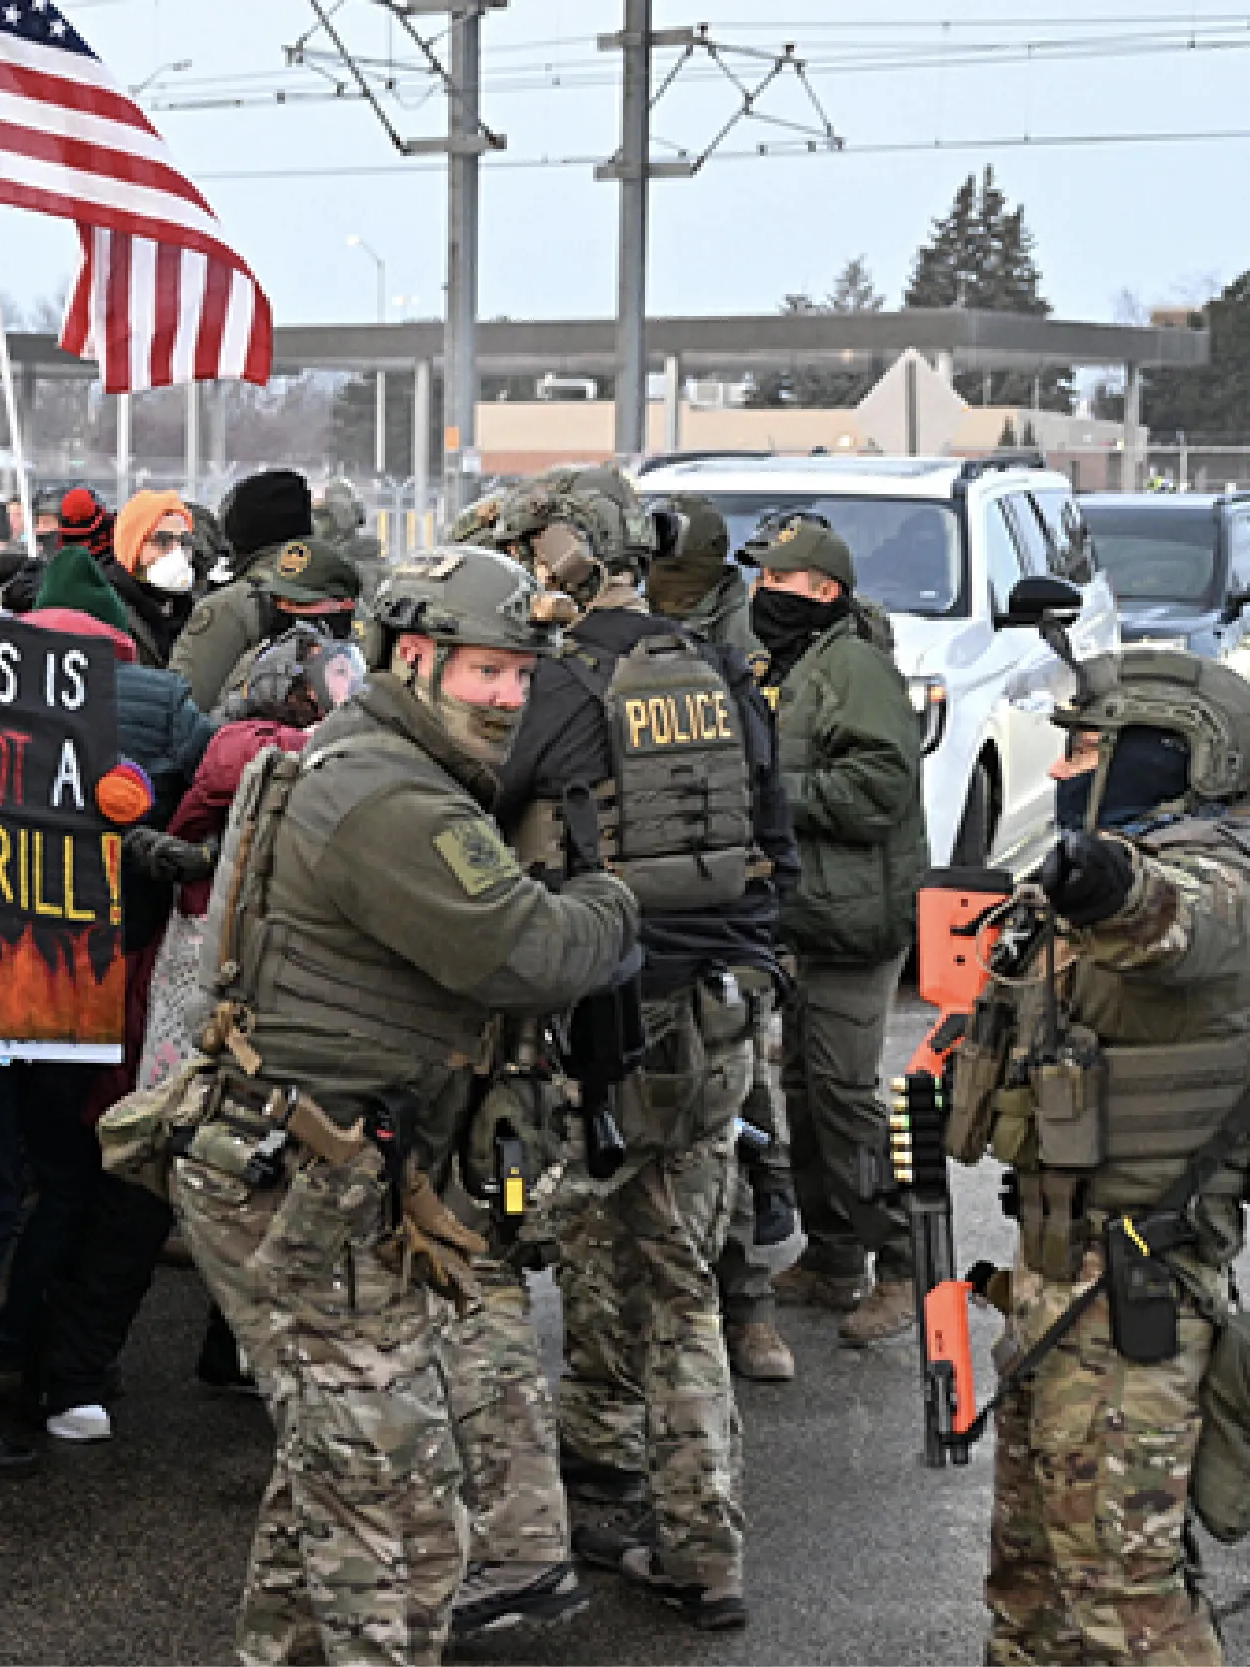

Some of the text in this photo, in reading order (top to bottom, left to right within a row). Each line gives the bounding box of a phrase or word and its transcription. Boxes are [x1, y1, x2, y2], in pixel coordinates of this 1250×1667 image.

[45, 649, 90, 710] IS
[624, 690, 735, 748] POLICE
[51, 738, 85, 814] A
